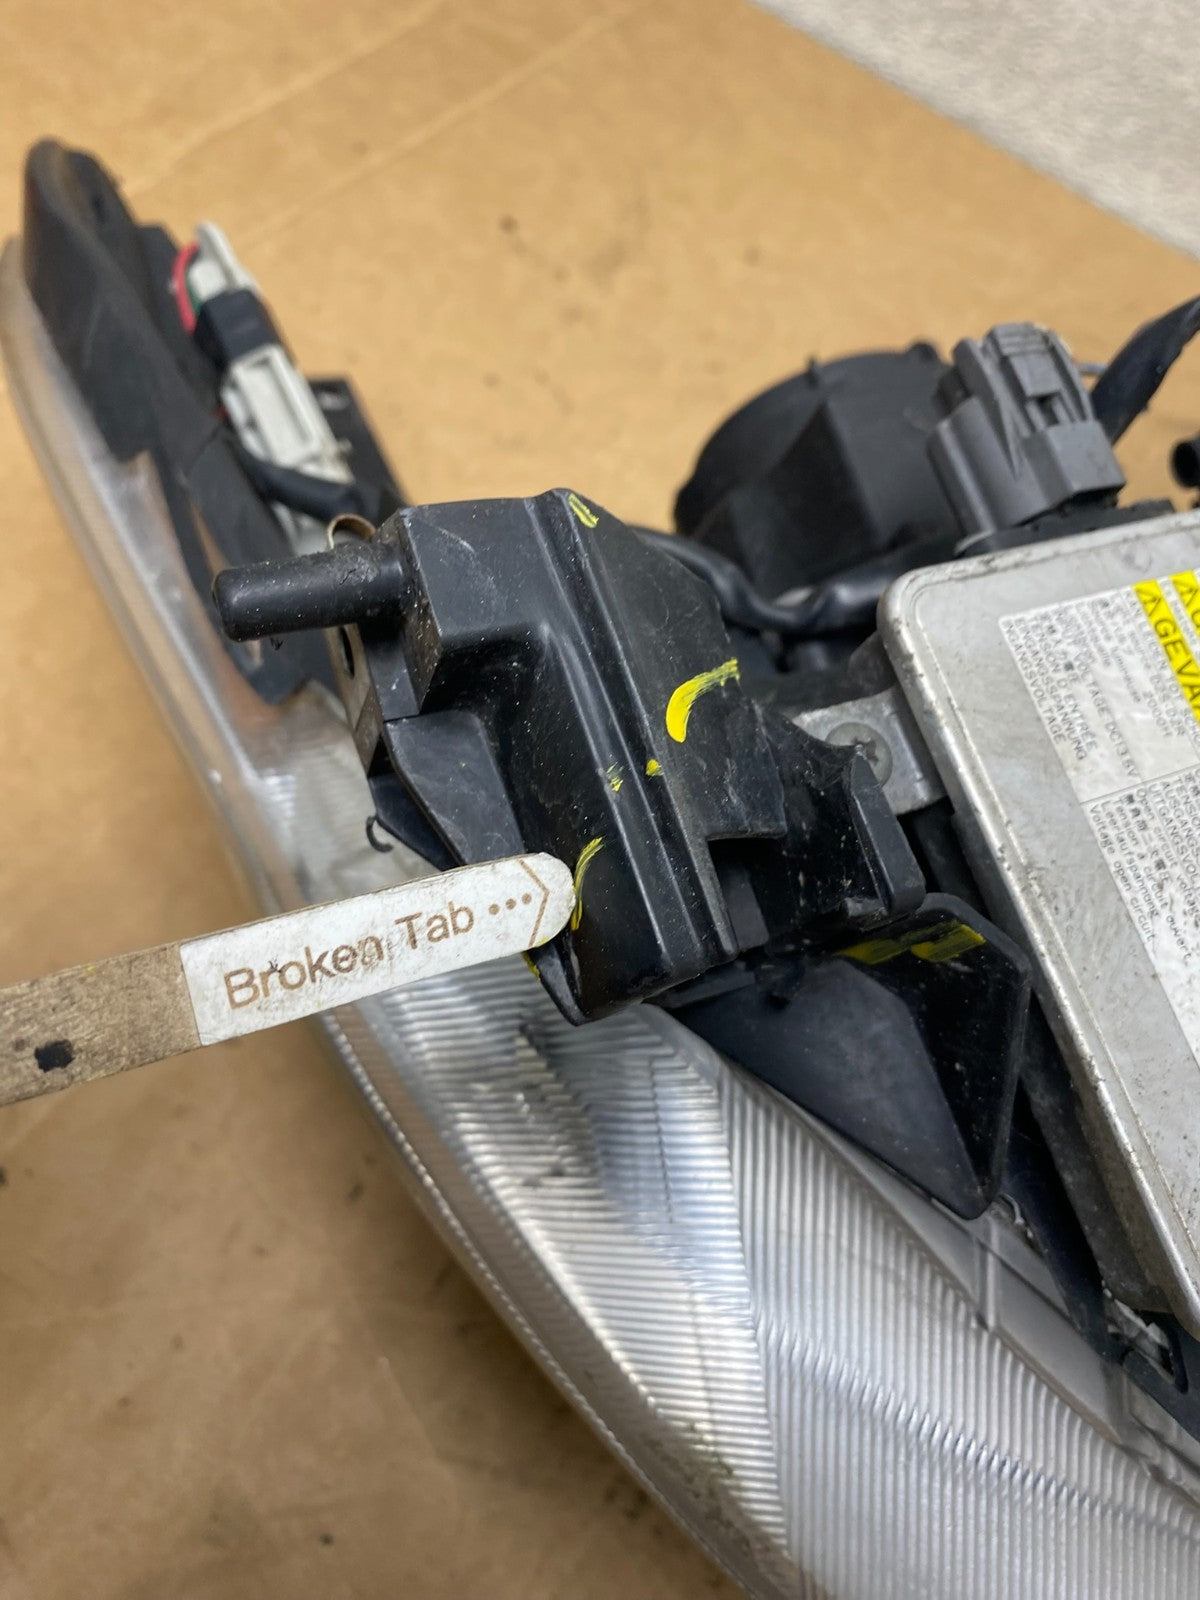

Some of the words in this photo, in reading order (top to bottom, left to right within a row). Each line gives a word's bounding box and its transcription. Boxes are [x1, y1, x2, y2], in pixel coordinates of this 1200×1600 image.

[1012, 617, 1087, 761] EINGANGSSPANNUNG
[1153, 616, 1200, 720] GEVA
[1084, 804, 1119, 856] Voltage
[1110, 859, 1134, 892] open
[1127, 896, 1157, 941] circuit
[1098, 800, 1161, 918] Leerlaufspannung
[1111, 798, 1140, 846] Tension
[1141, 865, 1169, 908] circuit
[1133, 787, 1157, 821] Open
[1151, 825, 1179, 868] circuit
[223, 935, 385, 1011] Broken
[394, 900, 475, 951] Tab
